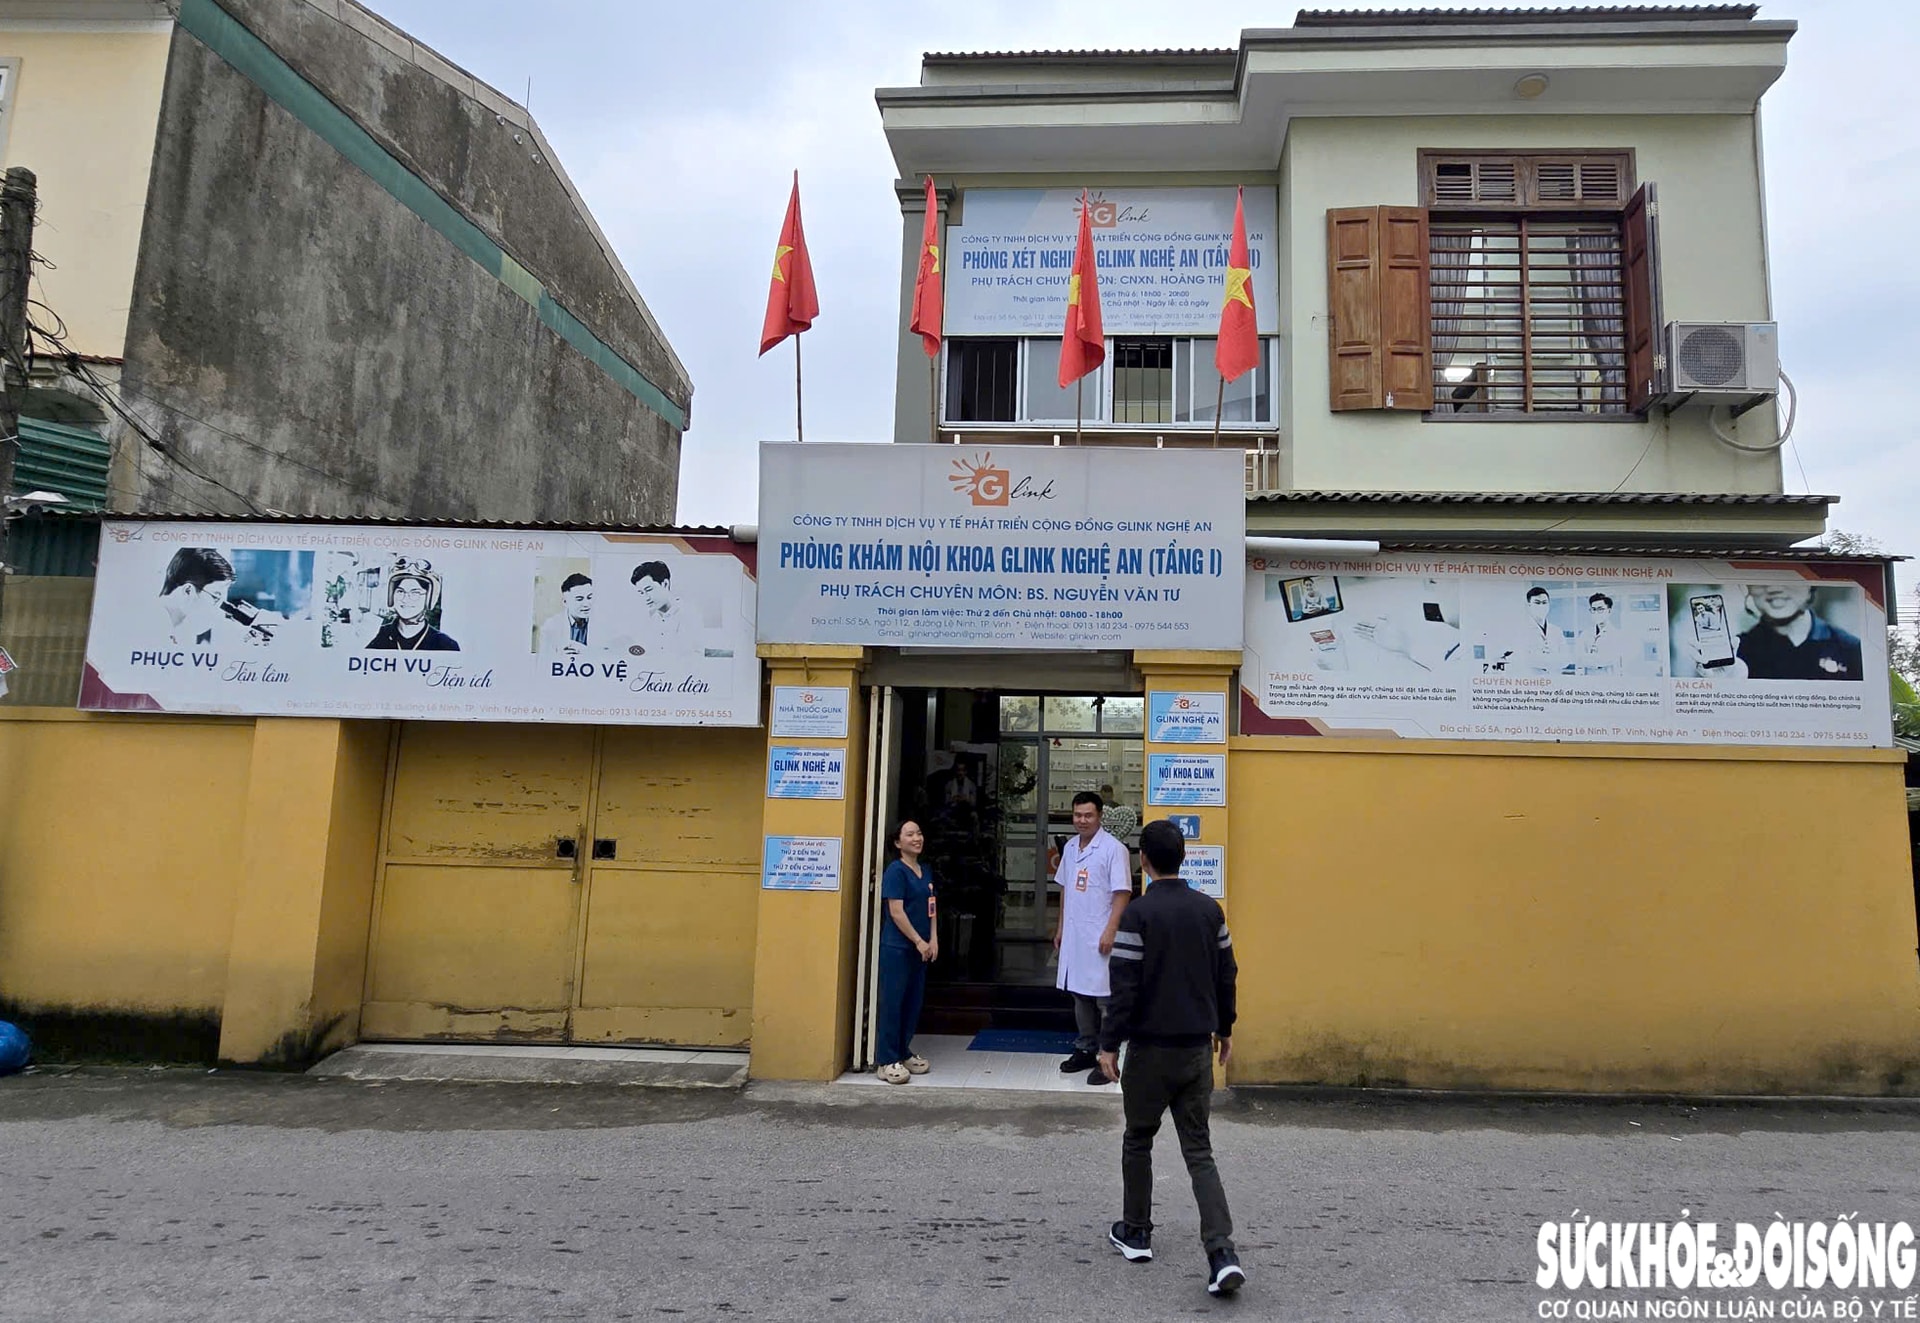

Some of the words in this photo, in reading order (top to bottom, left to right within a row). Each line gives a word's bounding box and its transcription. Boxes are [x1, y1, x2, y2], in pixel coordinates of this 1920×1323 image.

[963, 246, 1007, 268] PHÒNG
[1012, 246, 1035, 268] XÉT
[1097, 249, 1135, 267] GLINK
[1140, 245, 1174, 271] NGHỆ
[1179, 249, 1197, 266] AN
[1203, 243, 1231, 272] (TẦN
[972, 277, 992, 286] PHỤ
[996, 275, 1032, 285] TRÁCH
[1099, 274, 1116, 284] ÔN:
[1120, 275, 1156, 284] CNXN.
[1161, 272, 1204, 284] HOÀNG
[1208, 274, 1223, 285] THỊ
[793, 515, 831, 525] CÔNG
[835, 517, 847, 525] TY
[851, 517, 881, 526] TNHH
[886, 516, 914, 529] DỊCH
[919, 518, 934, 529] VỤ
[938, 519, 945, 527] Y
[949, 517, 964, 528] TẾ
[965, 517, 994, 528] PHÁT
[997, 517, 1028, 529] TRIỂN
[1032, 518, 1071, 532] CỘNG
[1074, 518, 1113, 530] ĐỒNG
[1117, 521, 1152, 531] GLINK
[1156, 519, 1189, 533] NGHỆ
[1194, 522, 1211, 531] AN
[780, 537, 842, 569] PHÒNG
[849, 538, 902, 570] KHÁM
[908, 540, 940, 576] NỘI
[946, 545, 994, 571] KHOA
[1001, 546, 1054, 572] GLINK
[1061, 542, 1110, 579] NGHỆ
[1116, 548, 1142, 574] AN
[1149, 539, 1203, 576] (TẦNG
[1210, 548, 1221, 576] I)
[1289, 560, 1326, 570] CÔNG
[1329, 562, 1341, 571] TY
[1344, 562, 1371, 571] TNHH
[1375, 563, 1402, 574] DỊCH
[1405, 563, 1420, 575] VỤ
[1423, 563, 1430, 573] Y
[1433, 561, 1446, 573] TẾ
[1448, 561, 1474, 573] PHÁT
[1478, 562, 1506, 574] TRIỂN
[1509, 564, 1545, 577] CỘNG
[1548, 563, 1583, 575] ĐỒNG
[1586, 567, 1619, 576] GLINK
[1622, 566, 1653, 579] NGHỆ
[1656, 568, 1673, 577] AN
[821, 584, 849, 599] PHỤ
[854, 581, 904, 597] TRÁCH
[910, 583, 972, 598] CHUYÊN
[978, 584, 1021, 599] MÔN:
[1027, 587, 1047, 599] BS.
[1054, 584, 1118, 600] NGUYỄN
[1124, 586, 1157, 601] VĂN
[1163, 588, 1180, 600] TƯ
[898, 608, 918, 616] gian
[942, 608, 963, 616] việc:
[992, 608, 1009, 616] đến
[1012, 609, 1030, 617] Chủ
[1034, 610, 1056, 619] nhật:
[1060, 610, 1086, 618] 08h00
[131, 651, 184, 669] PHỤC
[192, 652, 217, 670] VỤ
[348, 656, 396, 675] DỊCH
[404, 658, 430, 676] VỤ
[552, 659, 593, 676] BẢO
[601, 660, 626, 681] VỆ
[1156, 715, 1179, 723] GLINK
[1182, 715, 1204, 724] NGHỆ
[774, 760, 799, 771] GLINK
[802, 759, 825, 776] NGHỆ
[828, 761, 840, 772] AN
[1159, 765, 1170, 780] NỘI
[1173, 767, 1191, 778] KHOA
[1193, 767, 1214, 778] GLINK
[1178, 818, 1195, 836] 5A
